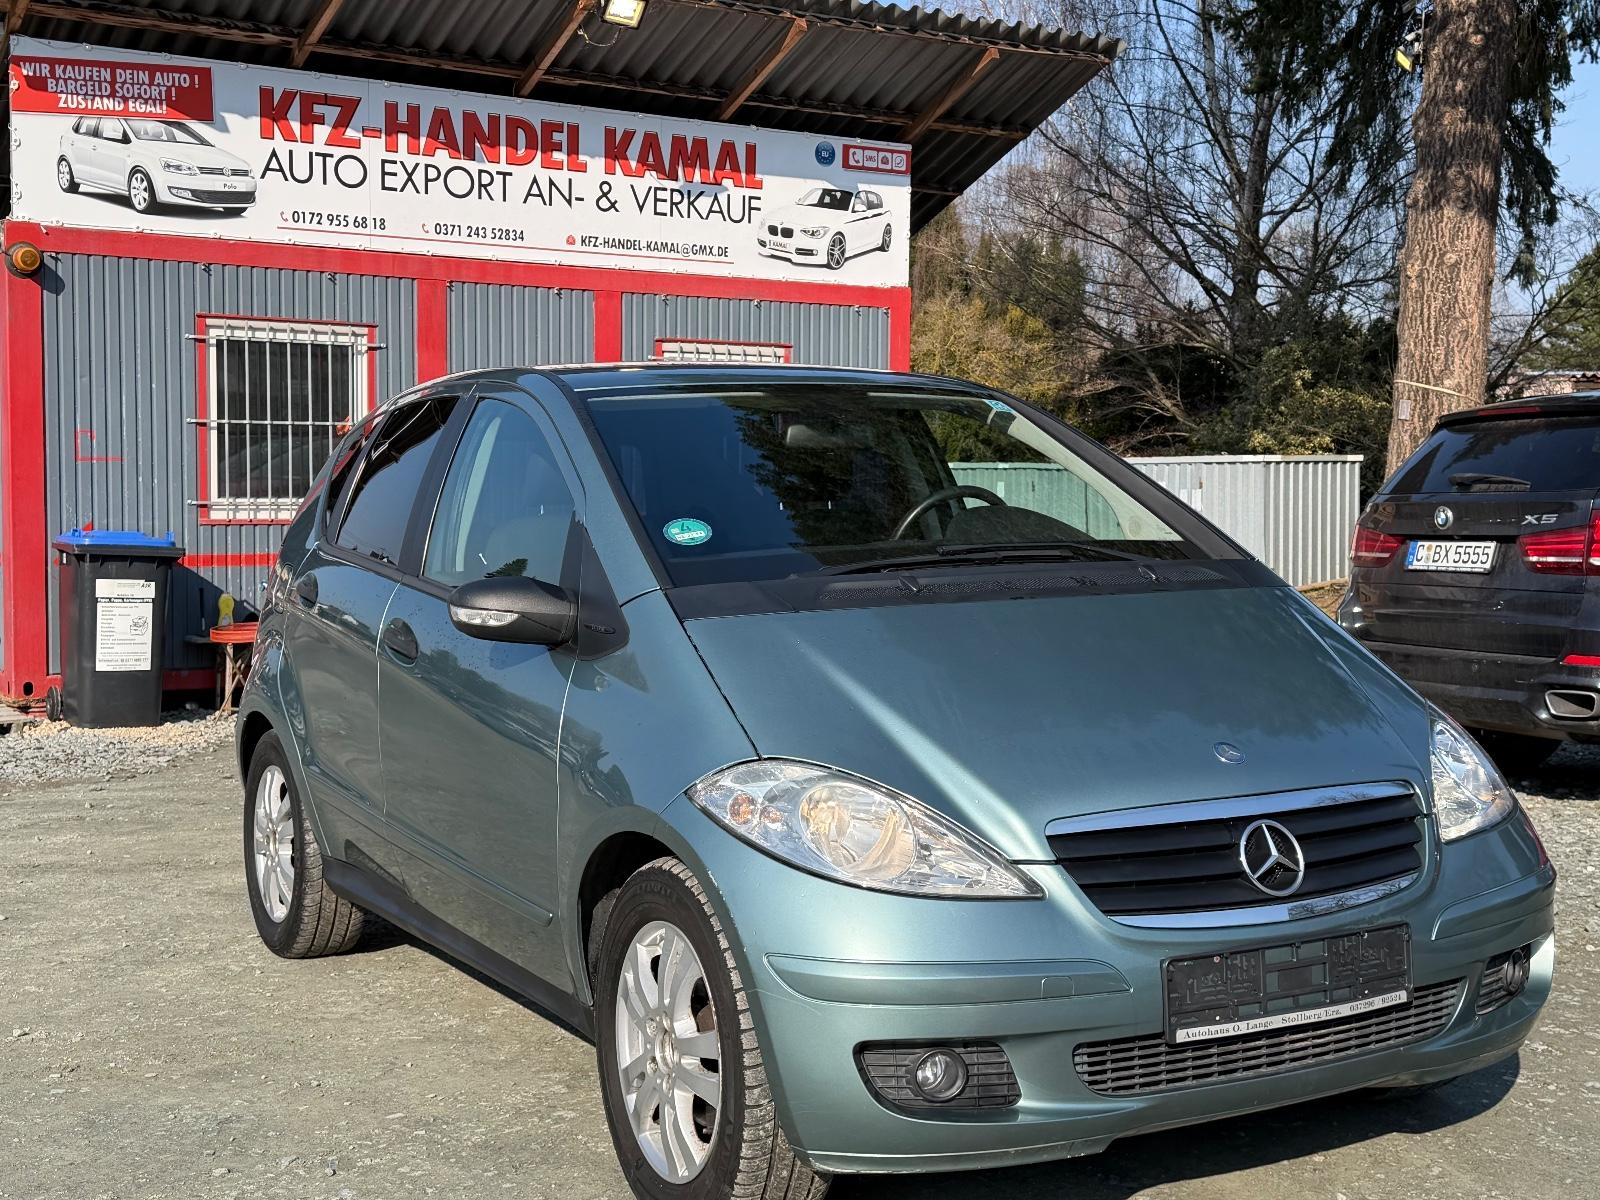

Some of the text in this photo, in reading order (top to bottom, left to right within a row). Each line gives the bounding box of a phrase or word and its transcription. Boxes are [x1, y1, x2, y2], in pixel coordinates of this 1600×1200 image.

[20, 61, 50, 77] WIR
[55, 64, 111, 82] KAUFEN
[116, 68, 149, 85] DEIN
[154, 71, 190, 88] AUTO
[47, 78, 111, 96] BARGELD
[115, 82, 167, 100] SOFORT
[57, 94, 168, 114] ZUSTAND EGAL!
[258, 84, 764, 190] KFZ-HANDEL KAMAL
[821, 150, 830, 158] EU
[865, 153, 877, 162] SMS
[260, 146, 763, 225] AUTO EXPORT AN- & VERKAUF
[292, 210, 386, 231] 0172 955 68 18
[434, 222, 525, 242] 0371 243 52834
[580, 234, 729, 258] KFZ-HANDEL-KAMAL@GMX.DE
[1521, 513, 1559, 525] X5
[1415, 544, 1491, 565] C BX 5555
[1183, 1026, 1230, 1039] Autohaus
[1232, 1024, 1242, 1033] O.
[1246, 1019, 1274, 1031] Lange
[1281, 1009, 1342, 1024] Stollberg/Erz.
[1349, 999, 1375, 1012] 037296
